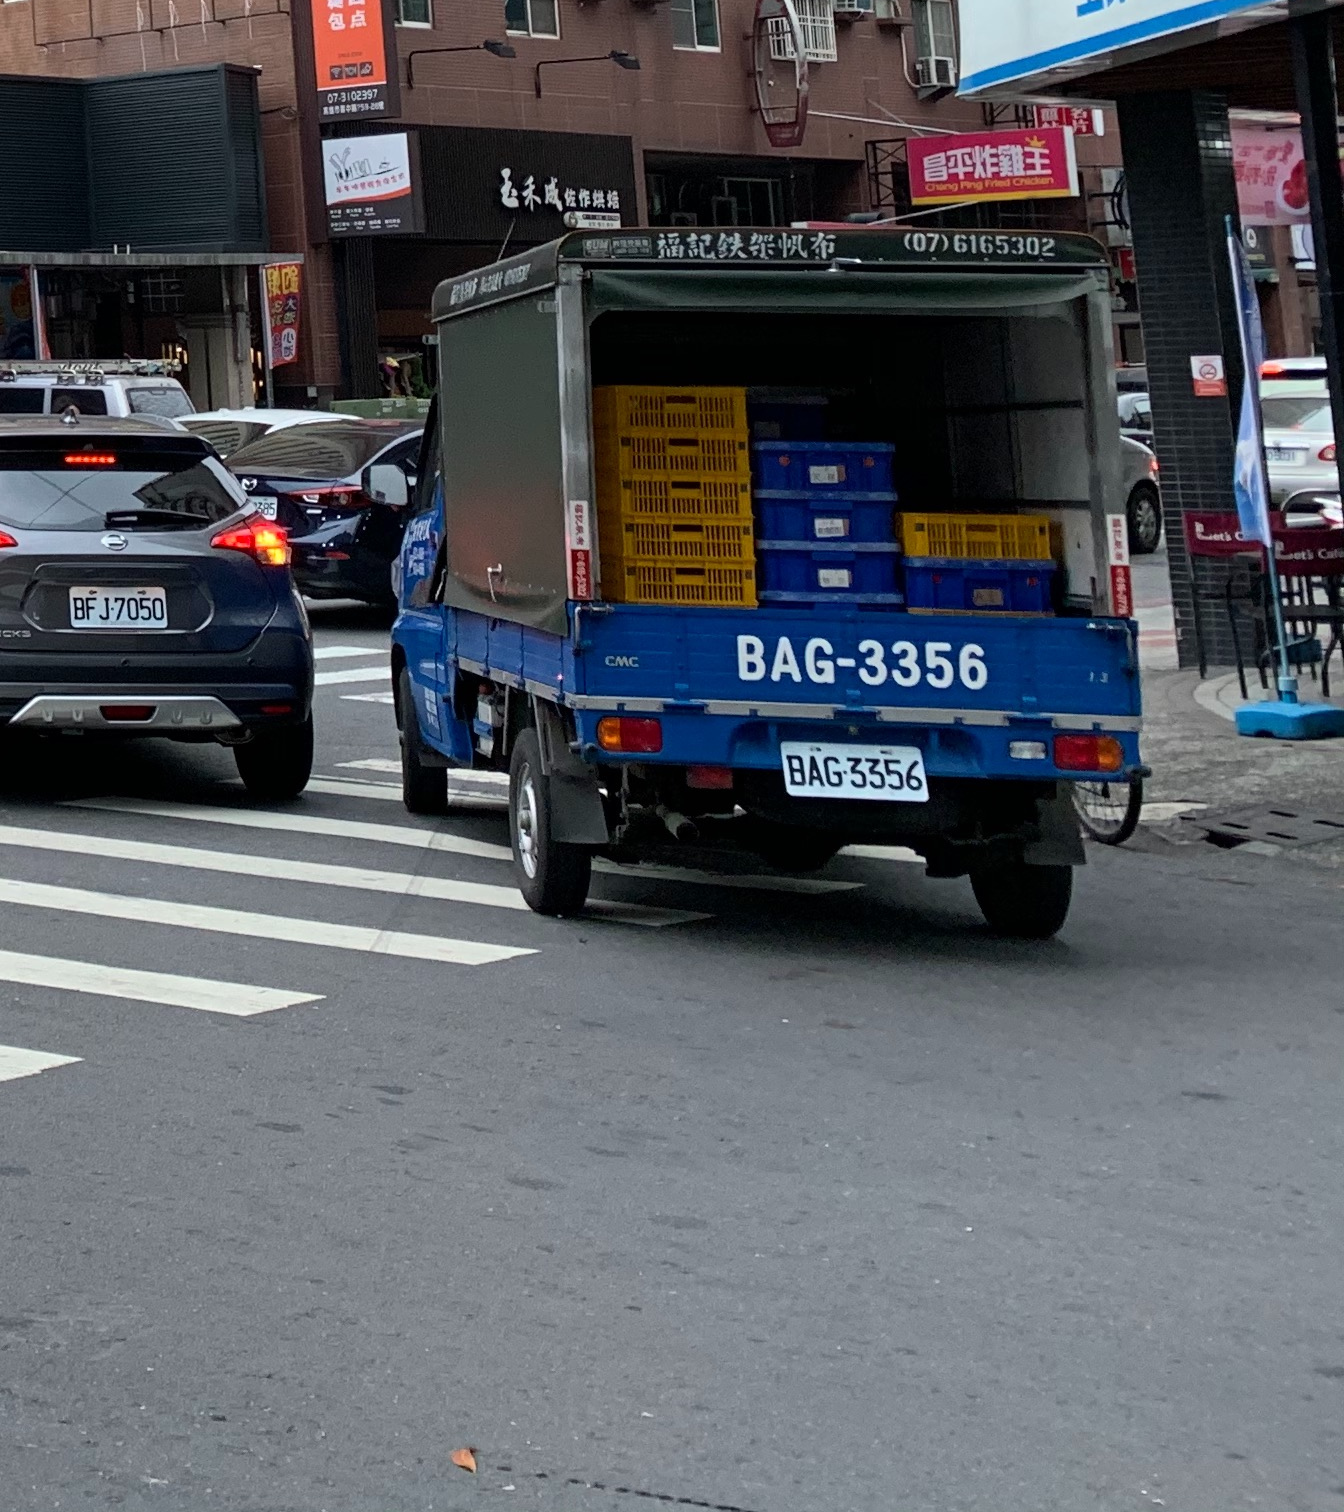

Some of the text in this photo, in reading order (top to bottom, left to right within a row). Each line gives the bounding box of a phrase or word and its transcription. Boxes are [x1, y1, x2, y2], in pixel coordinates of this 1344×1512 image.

[327, 88, 378, 104] 07-3102397
[923, 144, 1052, 183] 昌平炸雞王
[985, 178, 1011, 188] Fried
[1013, 176, 1054, 186] Chicken
[903, 233, 1057, 258] (07)6165302
[605, 656, 639, 667] CMC
[736, 635, 989, 691] BAG-3356
